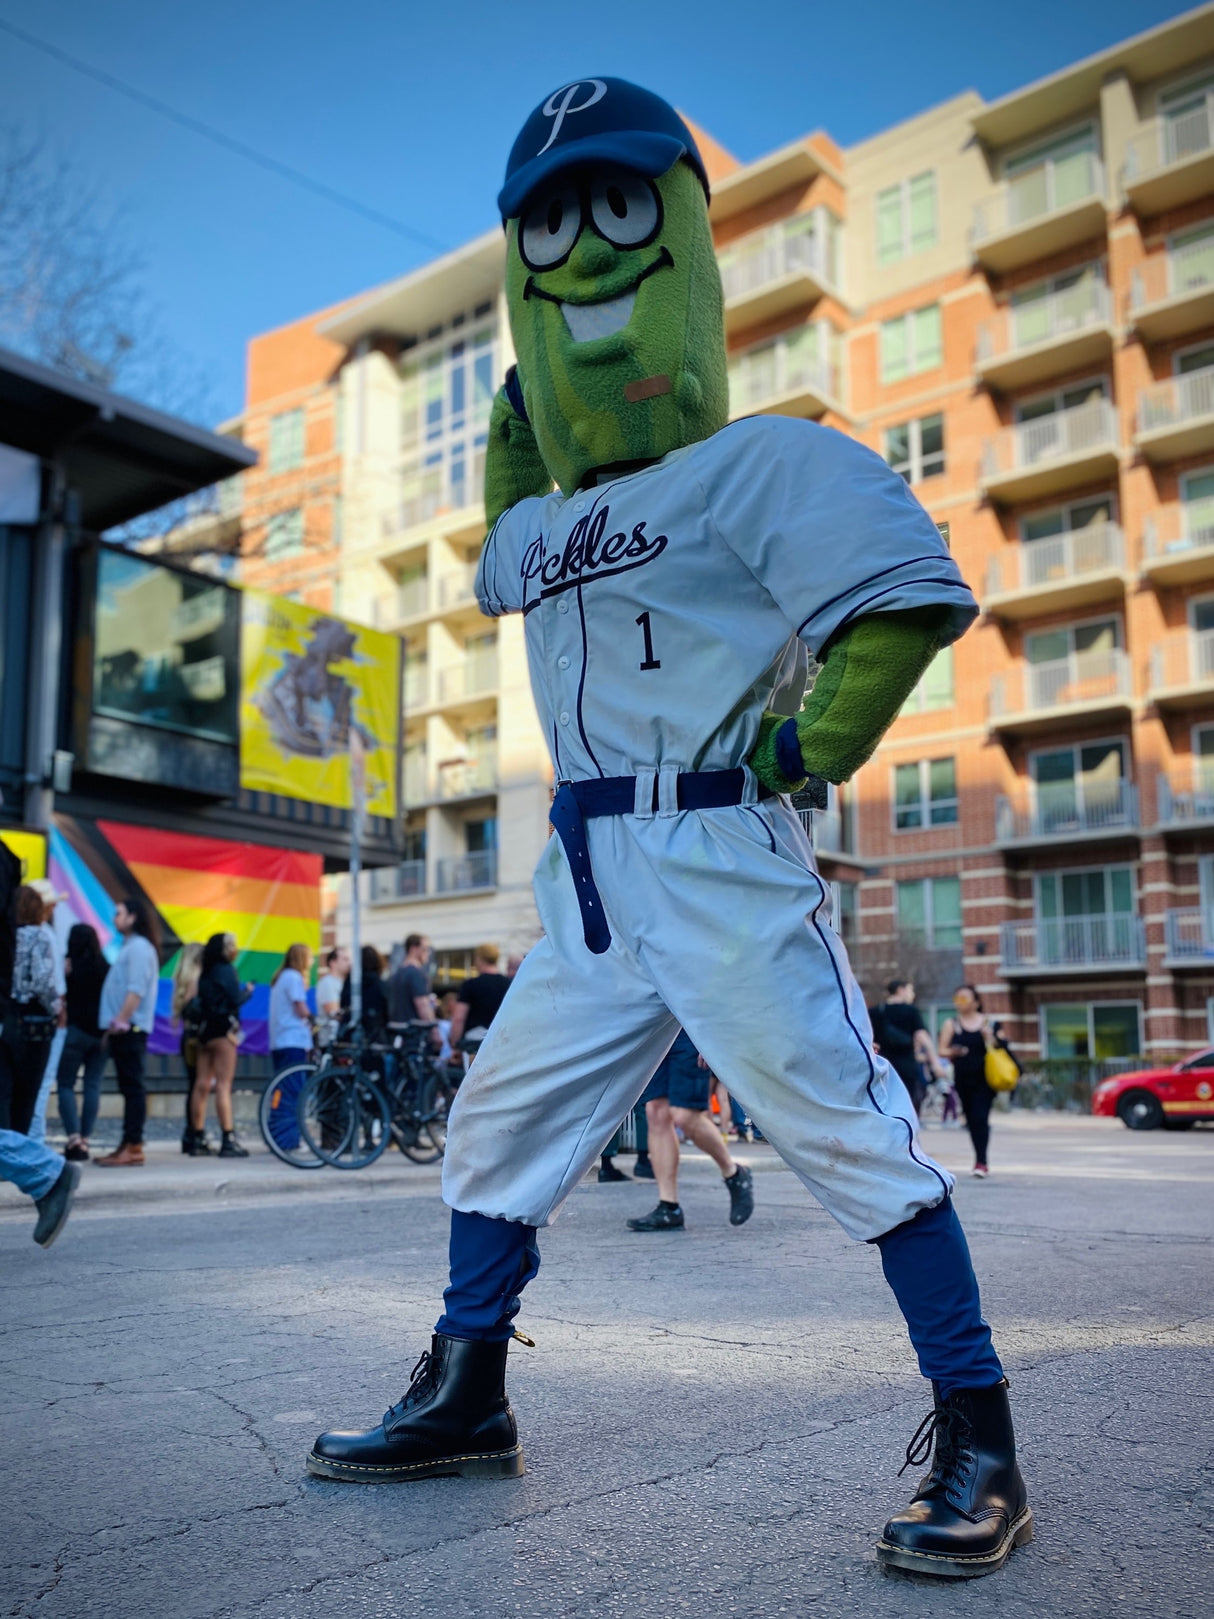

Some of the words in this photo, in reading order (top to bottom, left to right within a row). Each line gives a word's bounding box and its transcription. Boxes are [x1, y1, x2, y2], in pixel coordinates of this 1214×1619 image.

[537, 79, 608, 157] P
[520, 505, 669, 616] Pckles
[635, 611, 661, 671] 1
